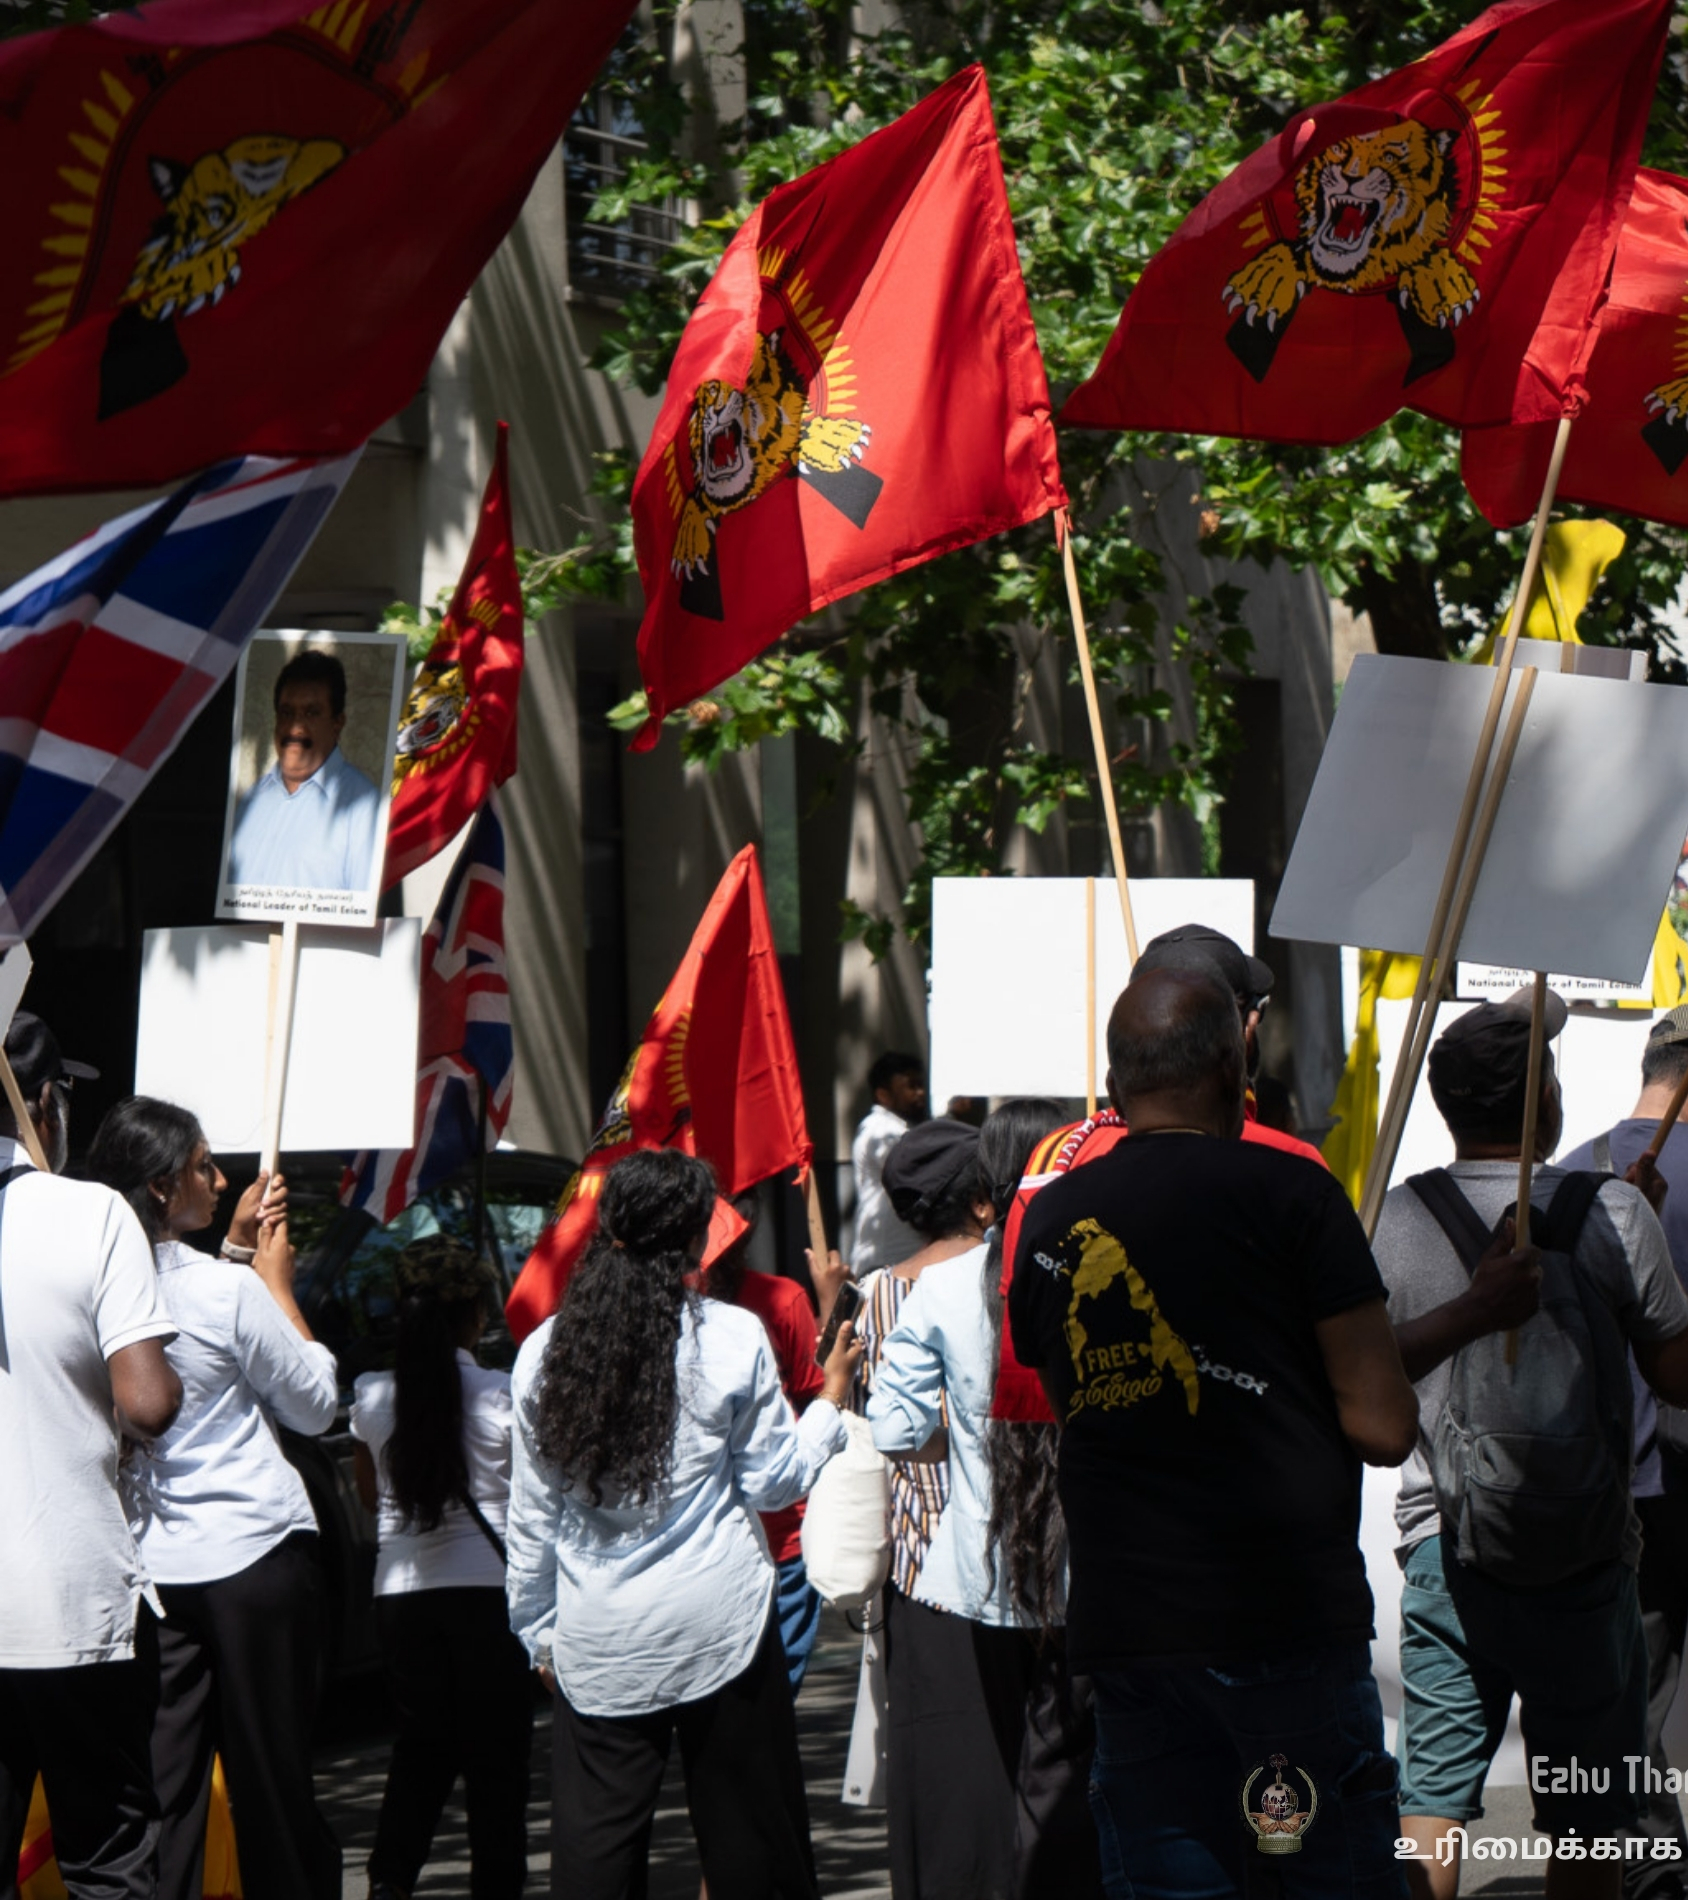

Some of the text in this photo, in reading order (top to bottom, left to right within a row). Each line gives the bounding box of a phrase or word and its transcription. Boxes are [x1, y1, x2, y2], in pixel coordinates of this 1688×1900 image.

[223, 899, 261, 909] National
[264, 902, 295, 911] Leader
[299, 904, 309, 912] of
[312, 904, 337, 914] Tamil
[1468, 979, 1515, 988] National
[1561, 980, 1572, 989] of
[1576, 980, 1604, 989] Tamil
[1085, 1342, 1138, 1373] FREE
